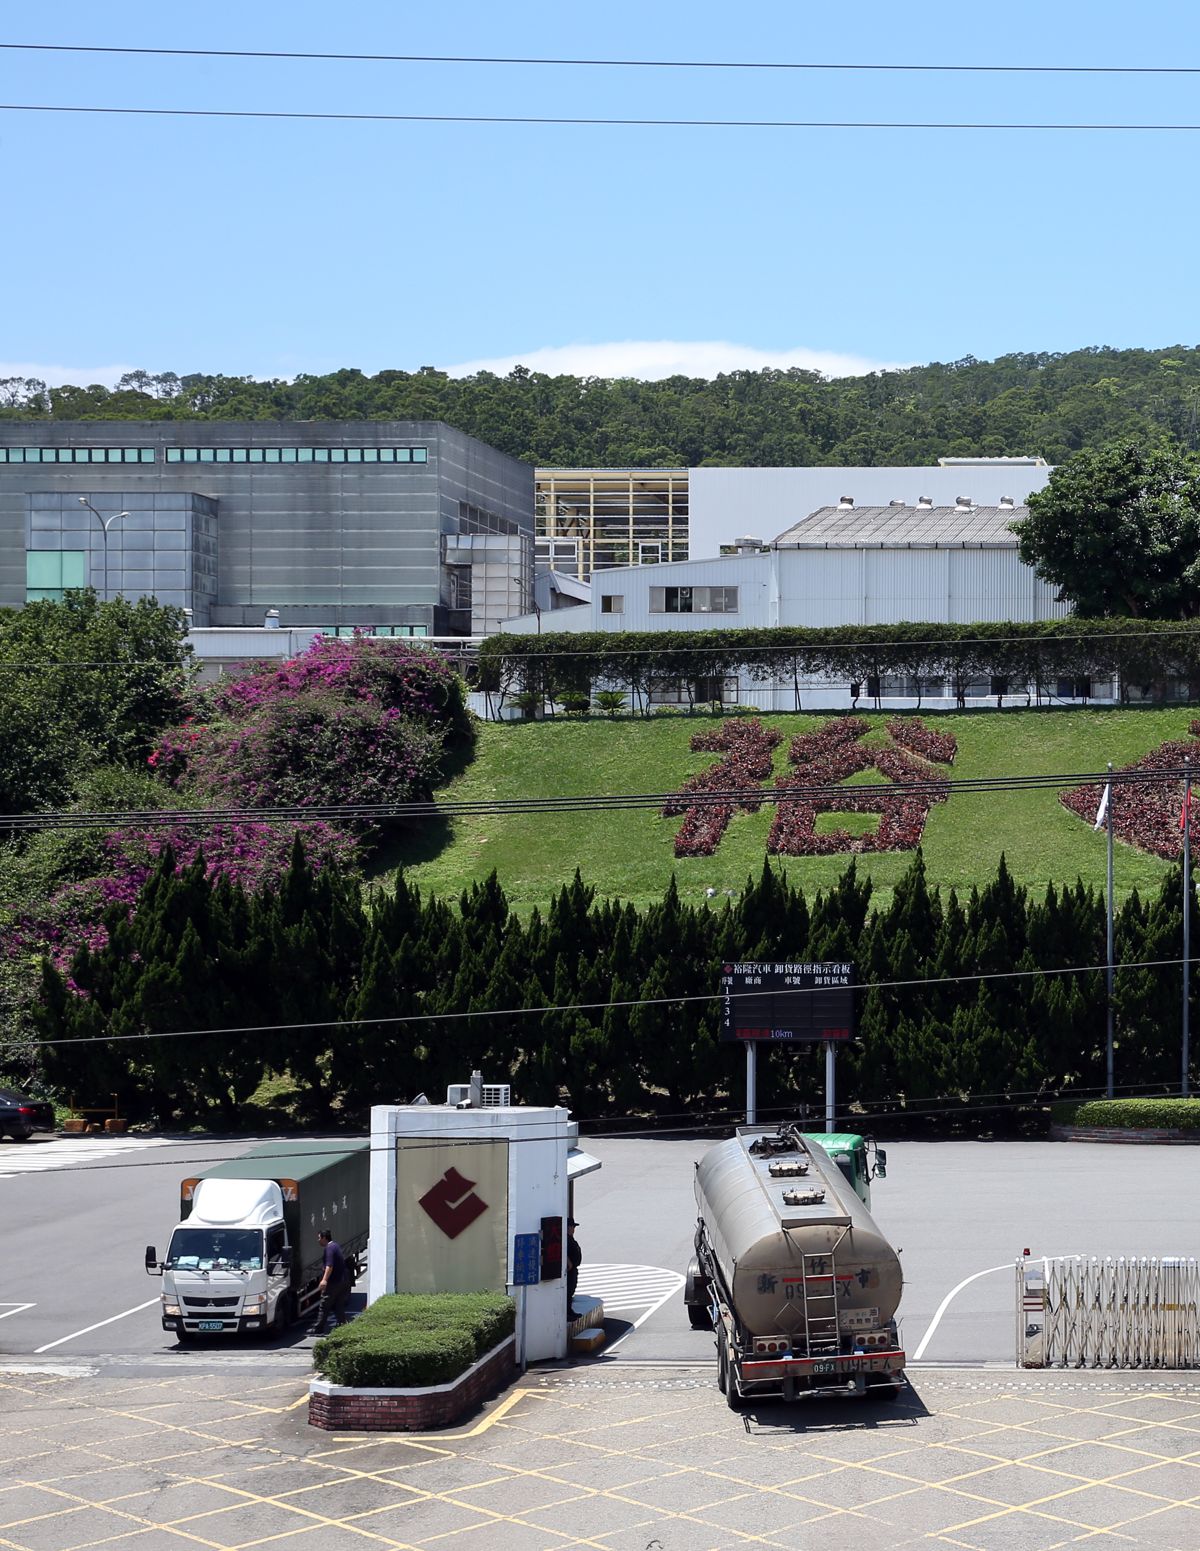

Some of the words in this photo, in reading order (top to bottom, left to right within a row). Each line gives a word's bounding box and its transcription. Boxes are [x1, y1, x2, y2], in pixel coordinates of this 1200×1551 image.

[733, 964, 771, 974] 裕隆汽車
[774, 964, 851, 974] 卸貨路徑指示看板
[784, 977, 801, 985] 車號
[814, 977, 849, 985] 卸貨區域
[725, 986, 729, 995] 1
[724, 996, 731, 1005] 2
[724, 1007, 731, 1016] 3
[724, 1018, 730, 1027] 4
[770, 1029, 793, 1038] 10km
